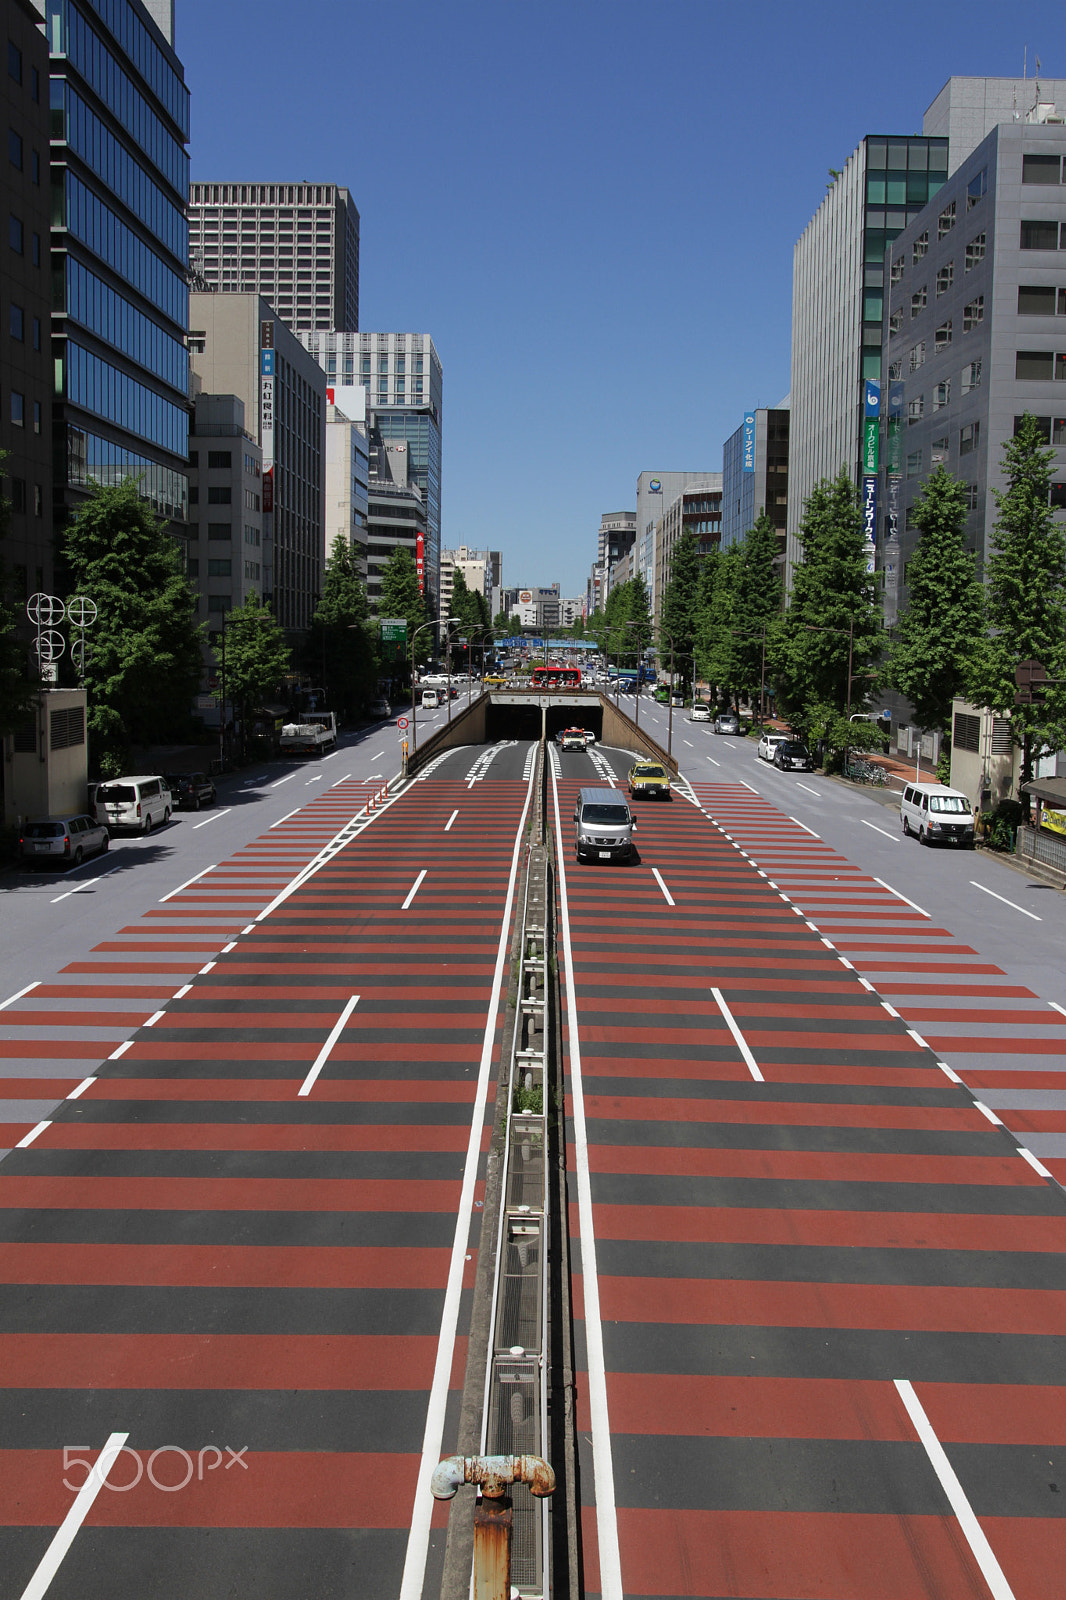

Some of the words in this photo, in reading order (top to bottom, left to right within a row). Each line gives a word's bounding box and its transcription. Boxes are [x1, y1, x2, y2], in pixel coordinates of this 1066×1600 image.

[865, 479, 875, 542] ニュートンワークス
